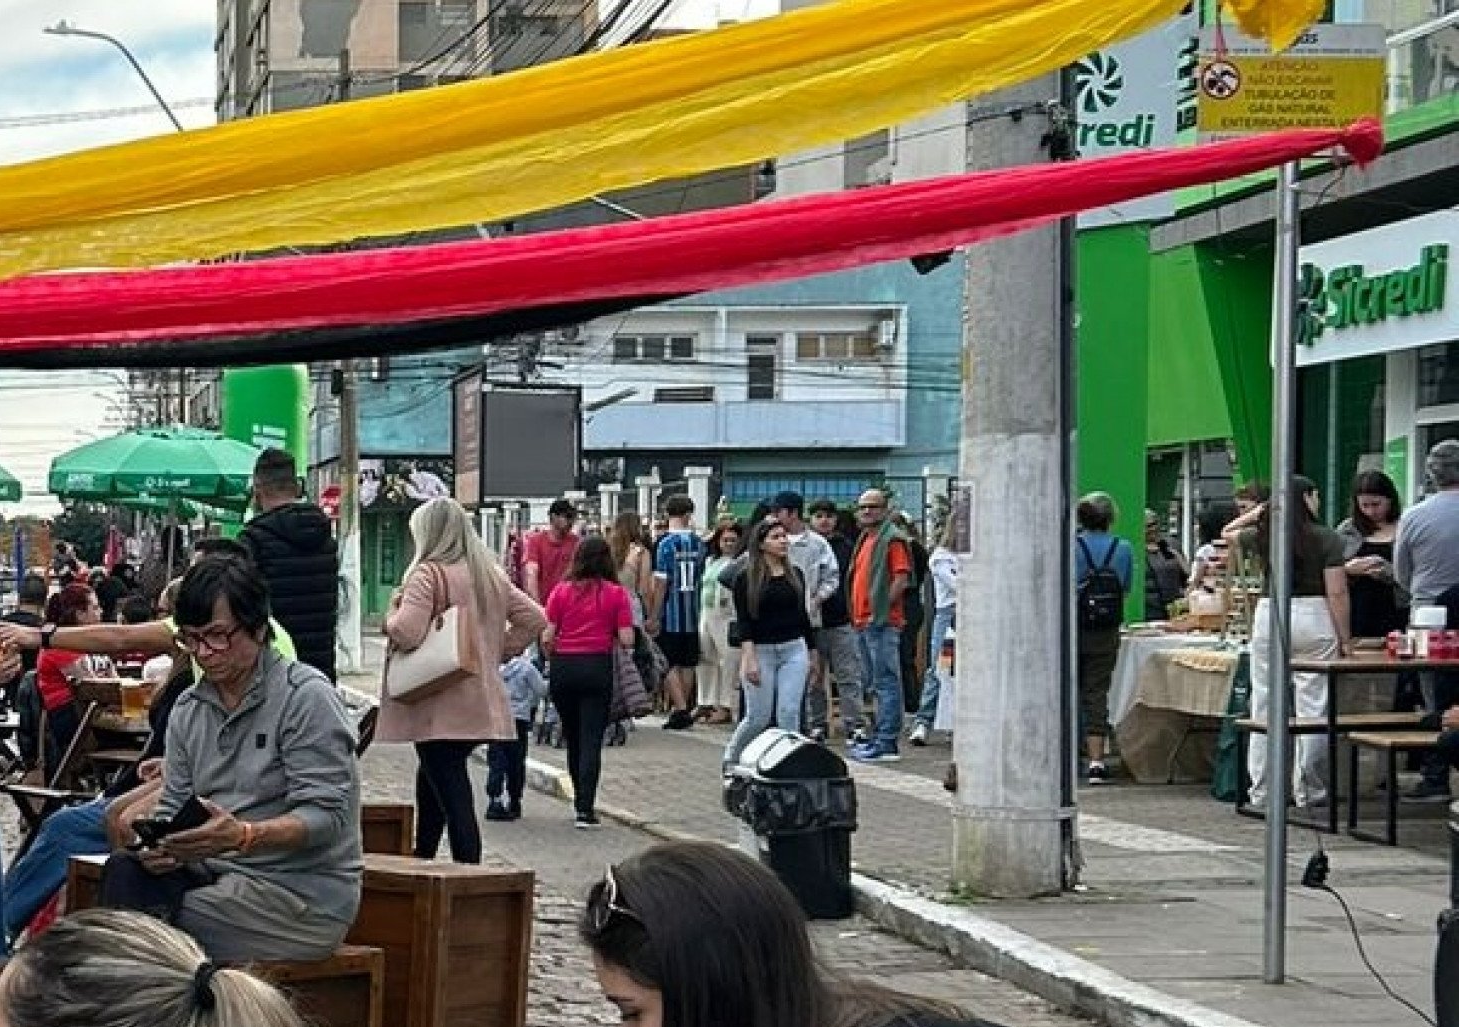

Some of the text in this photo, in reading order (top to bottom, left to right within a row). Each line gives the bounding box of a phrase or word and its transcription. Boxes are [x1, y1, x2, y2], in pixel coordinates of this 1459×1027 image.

[1261, 60, 1319, 72] ATENÇÃO
[1248, 73, 1333, 85] NÃO ESCAVAR
[1245, 87, 1336, 100] TUBULAÇÃO DE
[1248, 103, 1330, 114] GÁS NATURAL
[1221, 117, 1294, 127] ENTERRADA
[1079, 114, 1156, 147] redi
[1327, 244, 1449, 328] Sicredi
